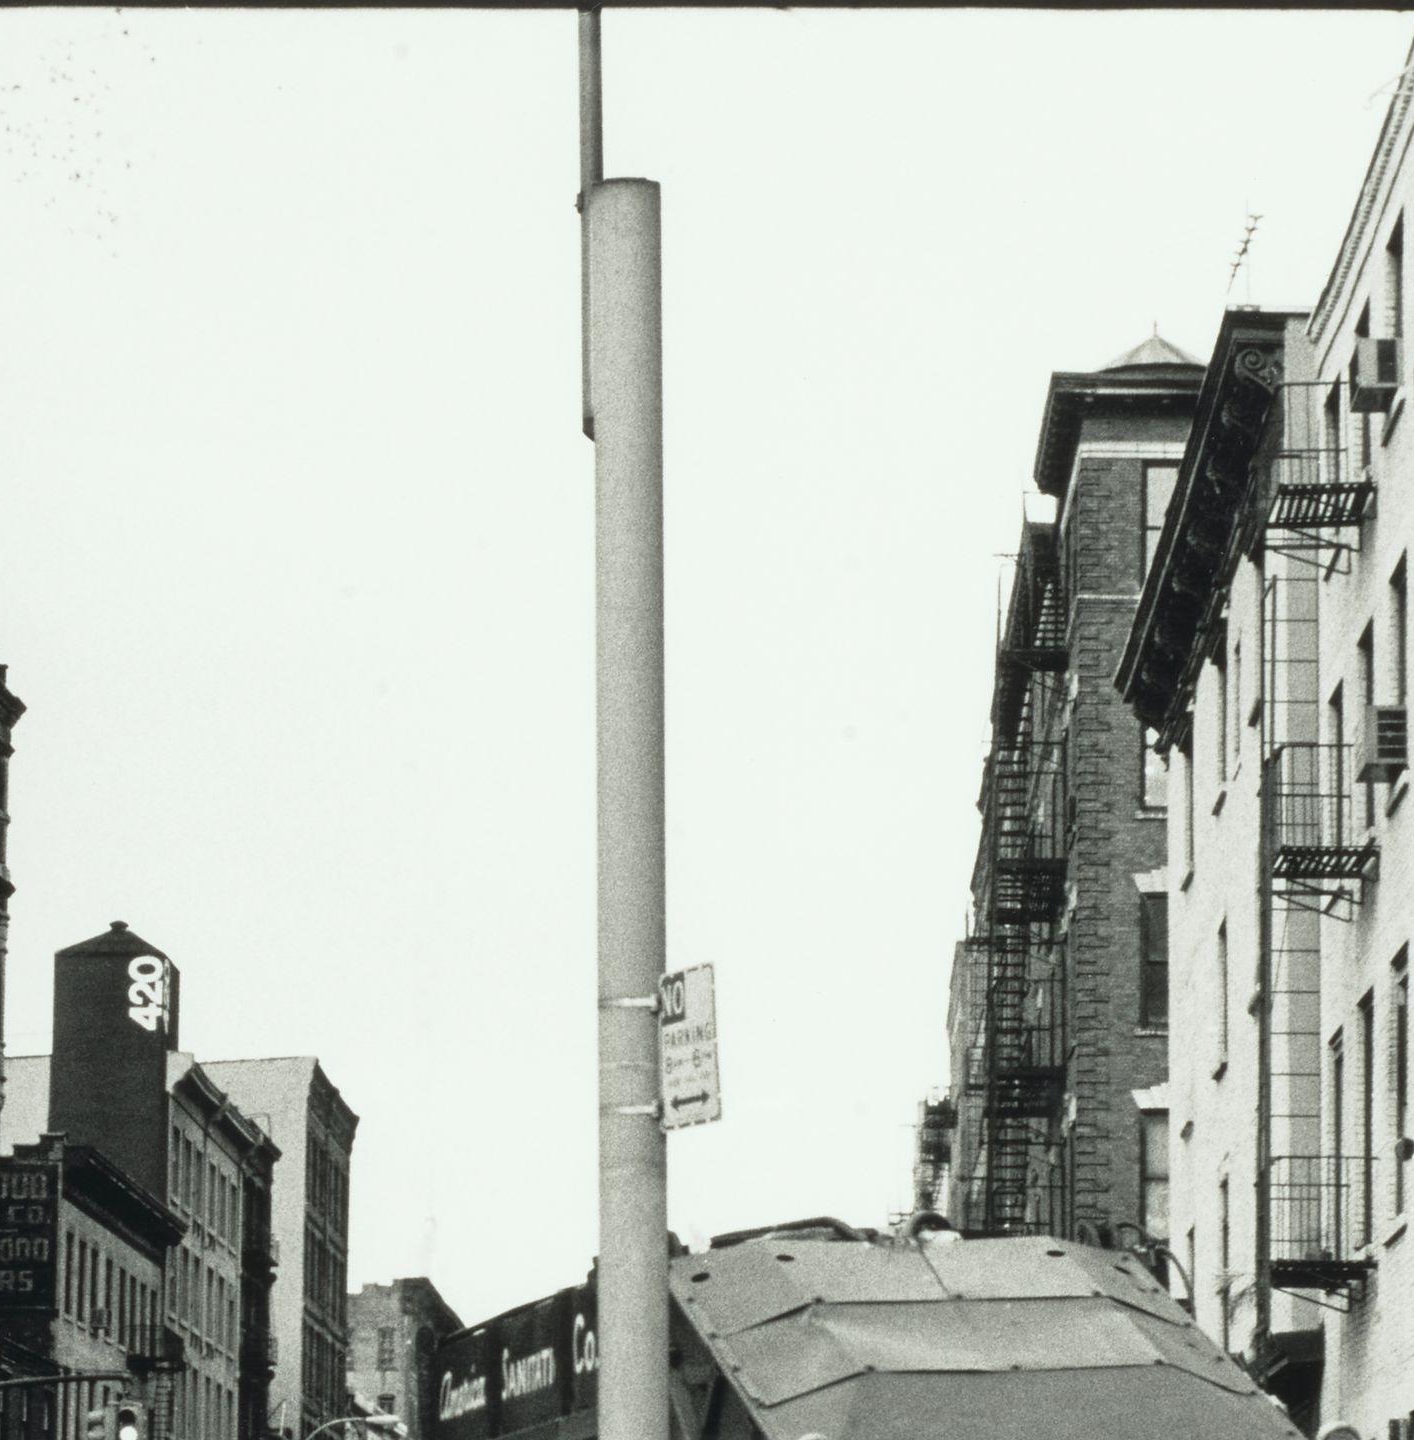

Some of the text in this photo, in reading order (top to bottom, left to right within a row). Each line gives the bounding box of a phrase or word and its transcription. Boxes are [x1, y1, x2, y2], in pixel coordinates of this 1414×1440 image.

[127, 954, 164, 1032] 420
[660, 980, 684, 1016] NO
[664, 1022, 714, 1047] PARKING
